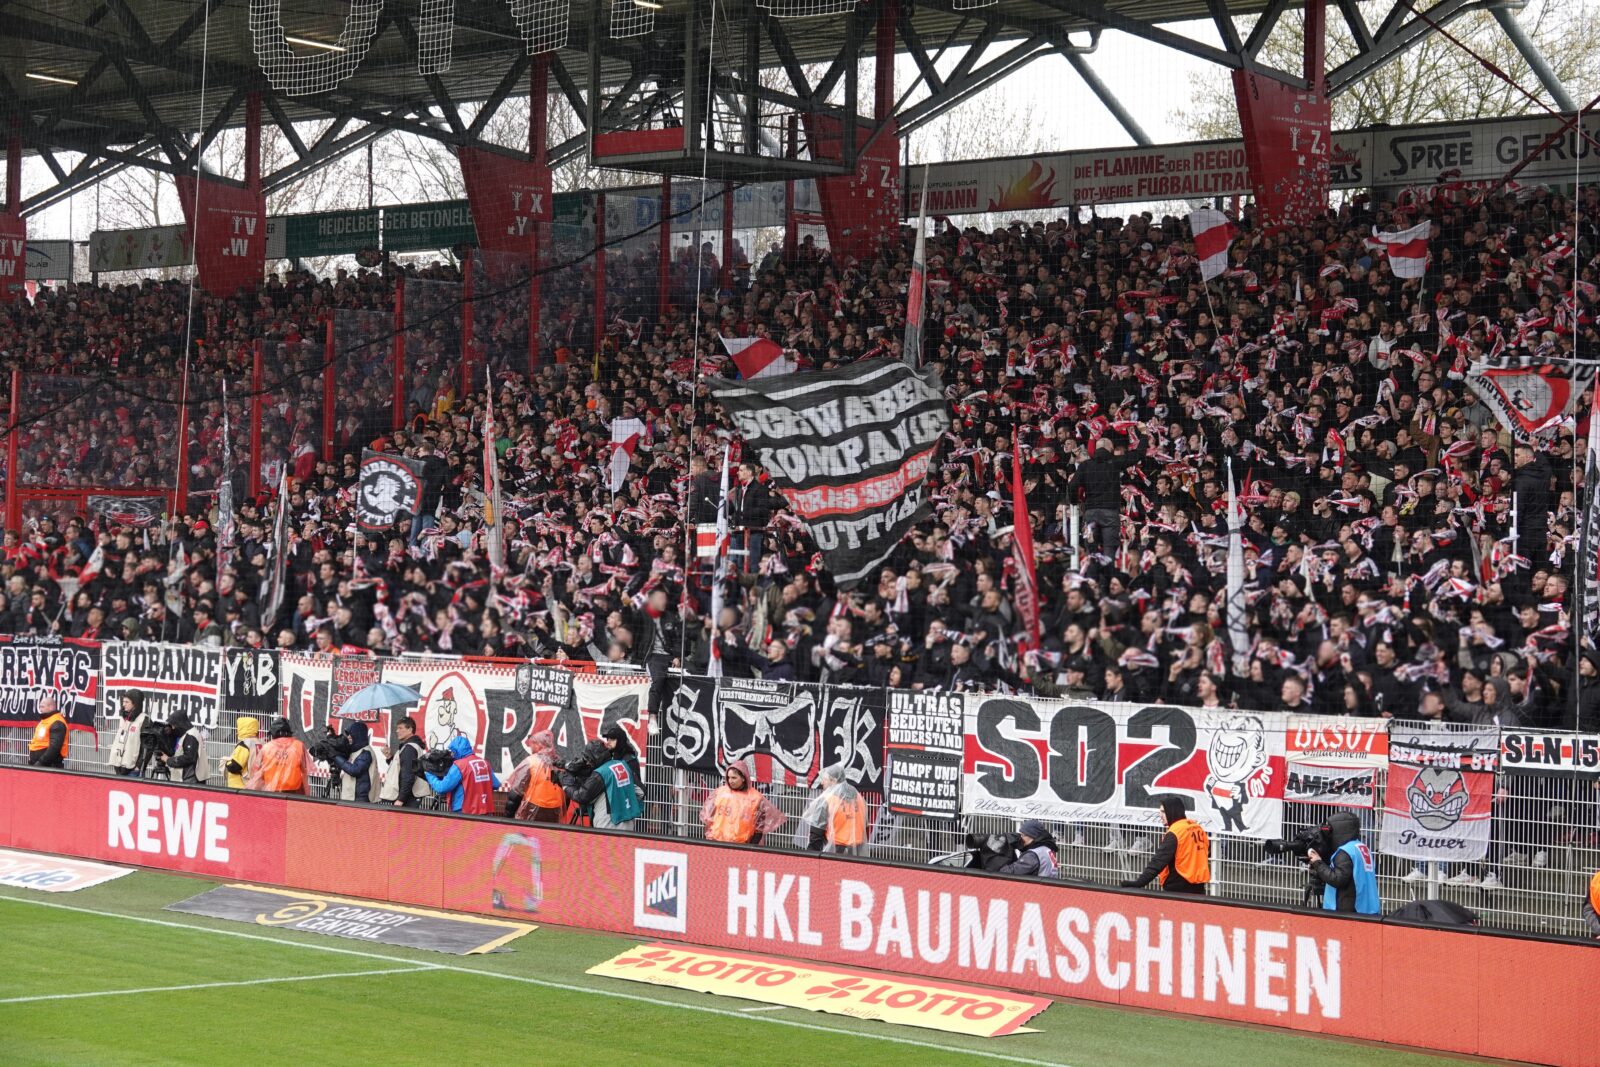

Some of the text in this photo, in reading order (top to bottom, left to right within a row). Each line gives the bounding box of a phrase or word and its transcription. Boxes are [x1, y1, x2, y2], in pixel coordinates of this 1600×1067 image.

[1094, 154, 1165, 177] FLAMME
[105, 644, 220, 685] SÜDBANDE
[532, 669, 570, 684] DU BIST
[531, 679, 569, 696] IMMER
[531, 691, 546, 700] BEI
[105, 689, 217, 725] STTGART
[891, 692, 962, 719] ULTRAS
[890, 713, 962, 734] BEDEUTET
[889, 729, 963, 749] WIDERSTAND
[1505, 734, 1600, 768] SLN 15
[892, 760, 958, 781] KAMPF UND
[891, 777, 957, 797] EINSATZ FÜR
[890, 793, 922, 807] UNSERE
[108, 790, 230, 863] REWE
[1398, 829, 1467, 850] Power
[645, 866, 677, 907] HKL
[323, 906, 420, 927] COMEDY
[296, 916, 391, 939] CENTRAL
[727, 867, 1341, 1018] HKL BAUMASCHINEN
